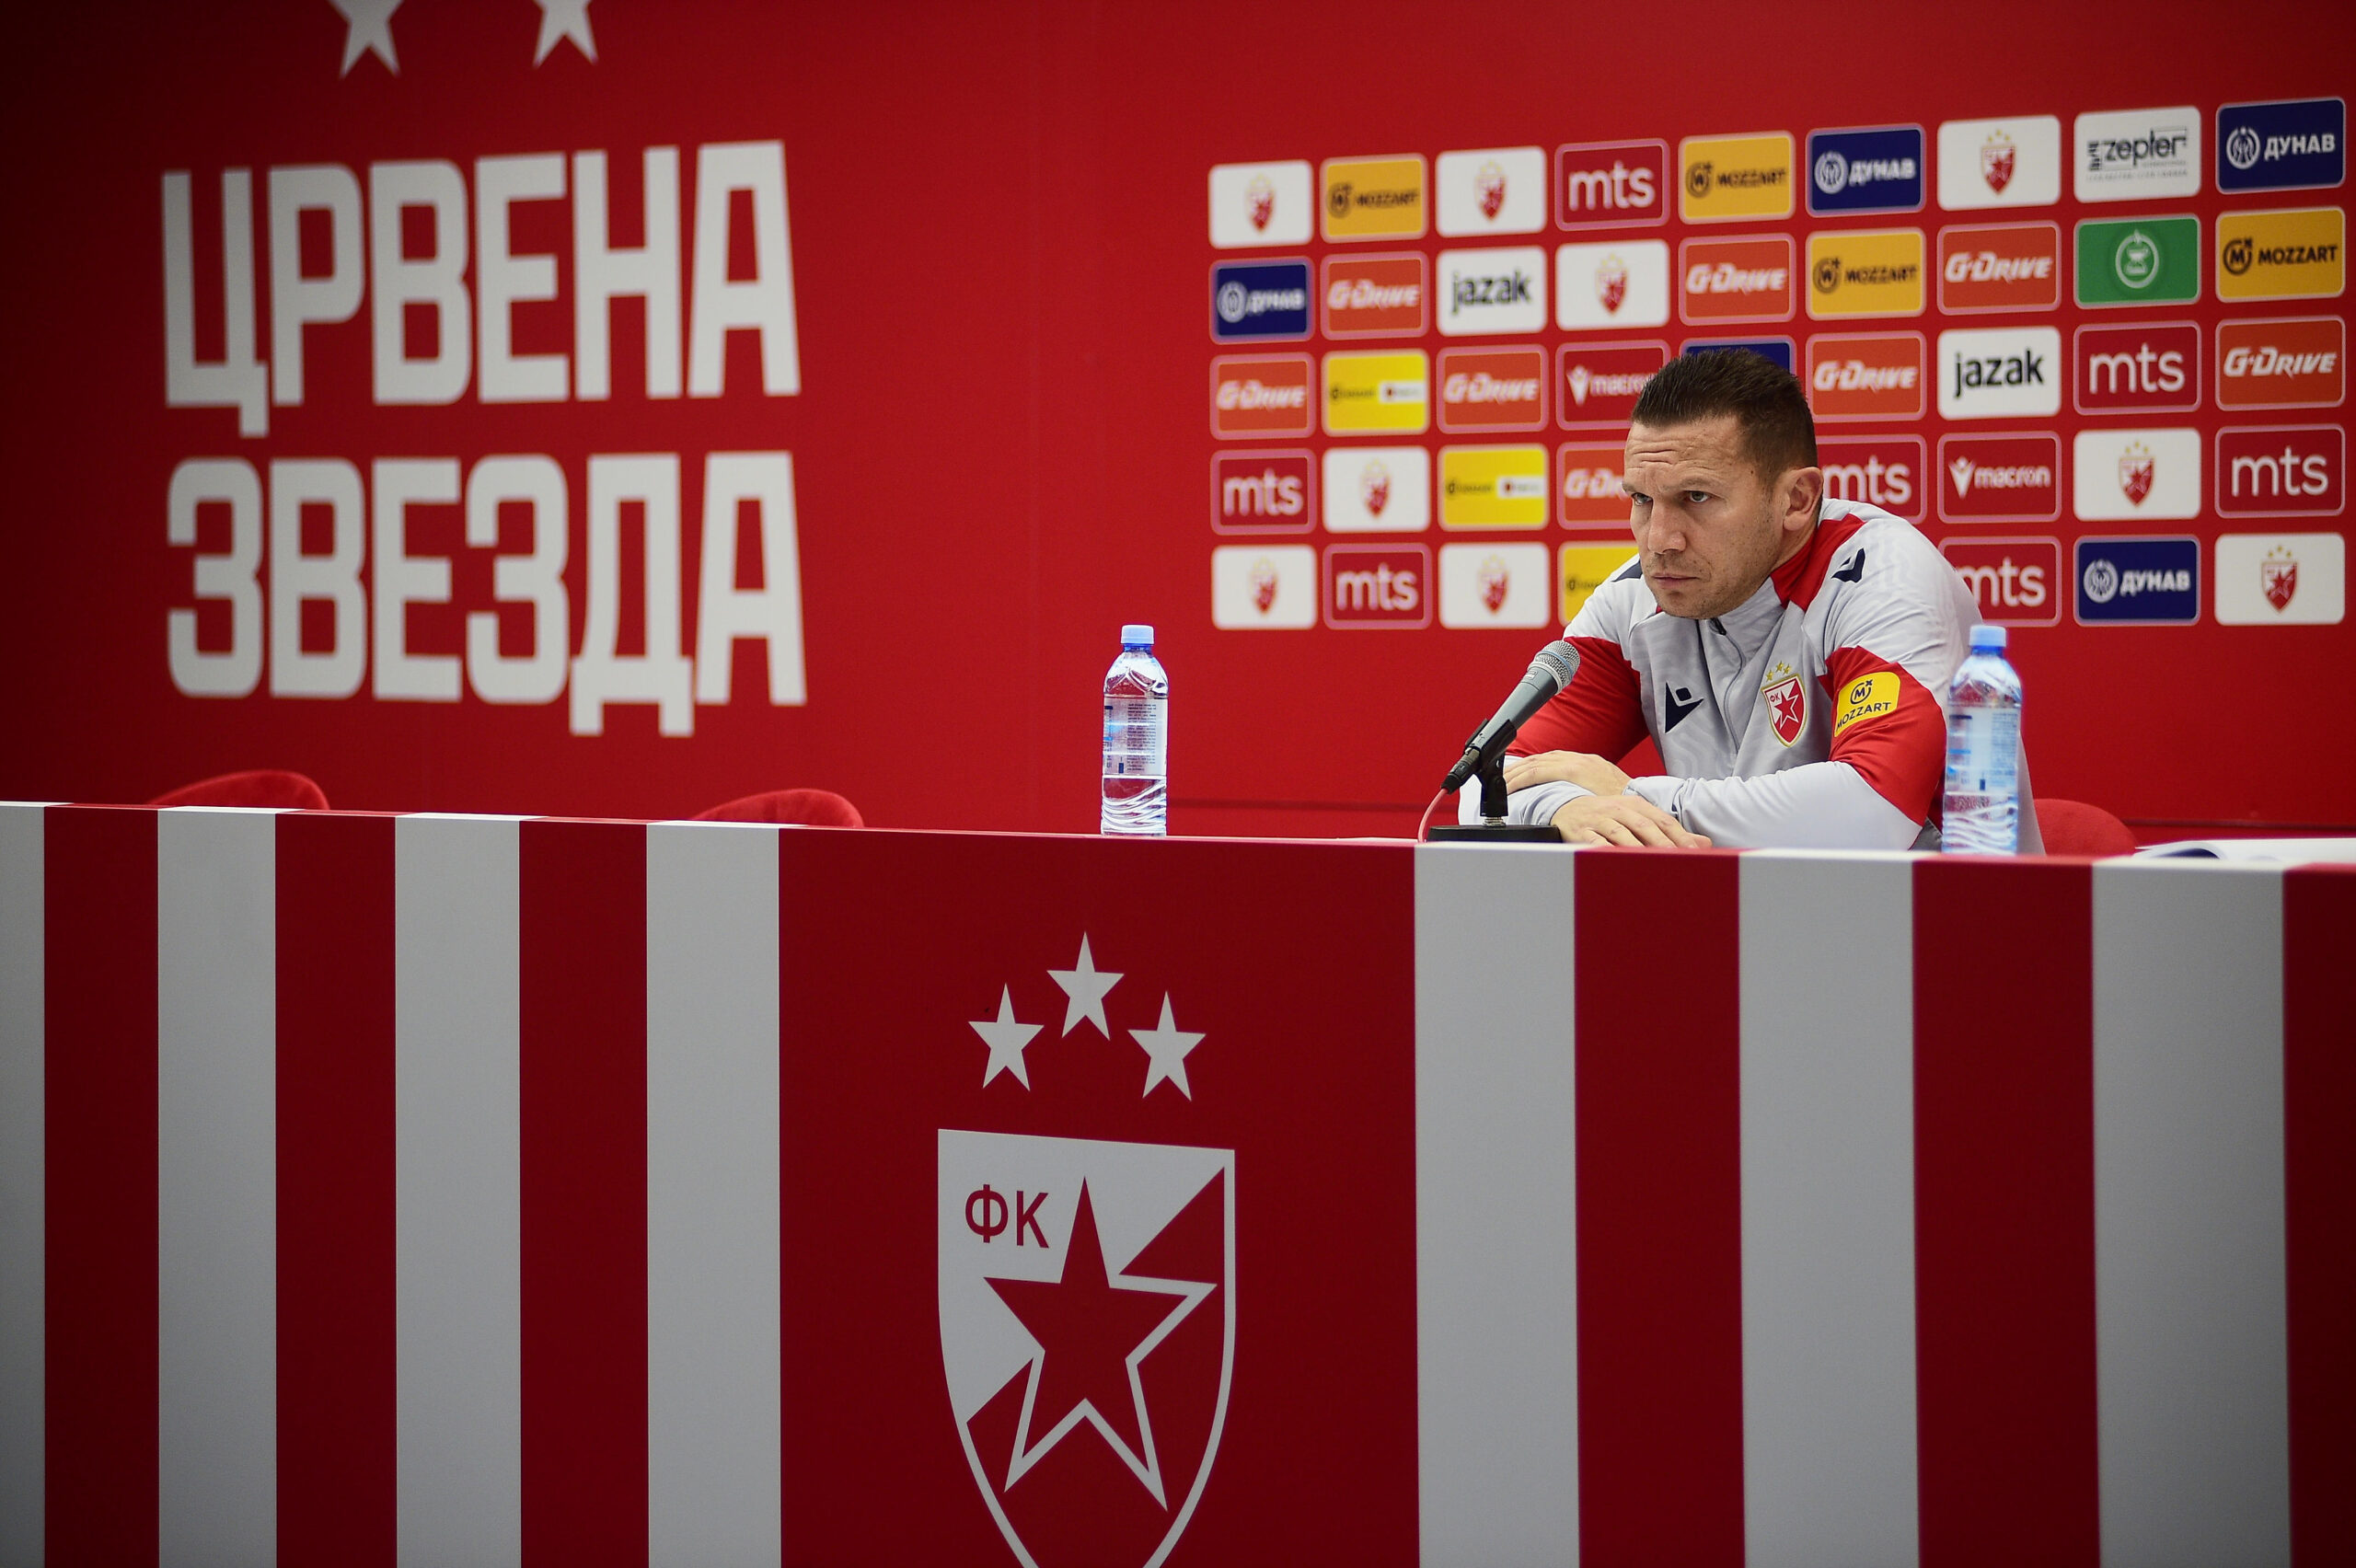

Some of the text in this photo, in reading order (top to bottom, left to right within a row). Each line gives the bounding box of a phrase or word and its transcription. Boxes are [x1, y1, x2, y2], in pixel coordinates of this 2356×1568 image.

[2102, 130, 2187, 167] zepter
[2264, 133, 2336, 161] ДУНАВ
[1569, 161, 1655, 211] mts
[1848, 158, 1916, 185] ДУНАВ
[2258, 245, 2338, 265] MOZZART
[163, 140, 801, 437] ЦРВЕНА
[1451, 271, 1531, 315] jazak
[1955, 349, 2044, 399] jazak
[2089, 342, 2185, 394] mts
[1224, 469, 1303, 516] mts
[1822, 455, 1911, 505] mts
[1974, 465, 2051, 489] macron
[2232, 446, 2329, 497] mts
[167, 450, 807, 737] ЗВЕЗДА
[1335, 563, 1418, 611] mts
[1956, 557, 2047, 607] mts
[2119, 570, 2190, 596] ДУНАВ
[1836, 701, 1891, 732] MOZZART
[964, 1183, 1050, 1249] ФК
